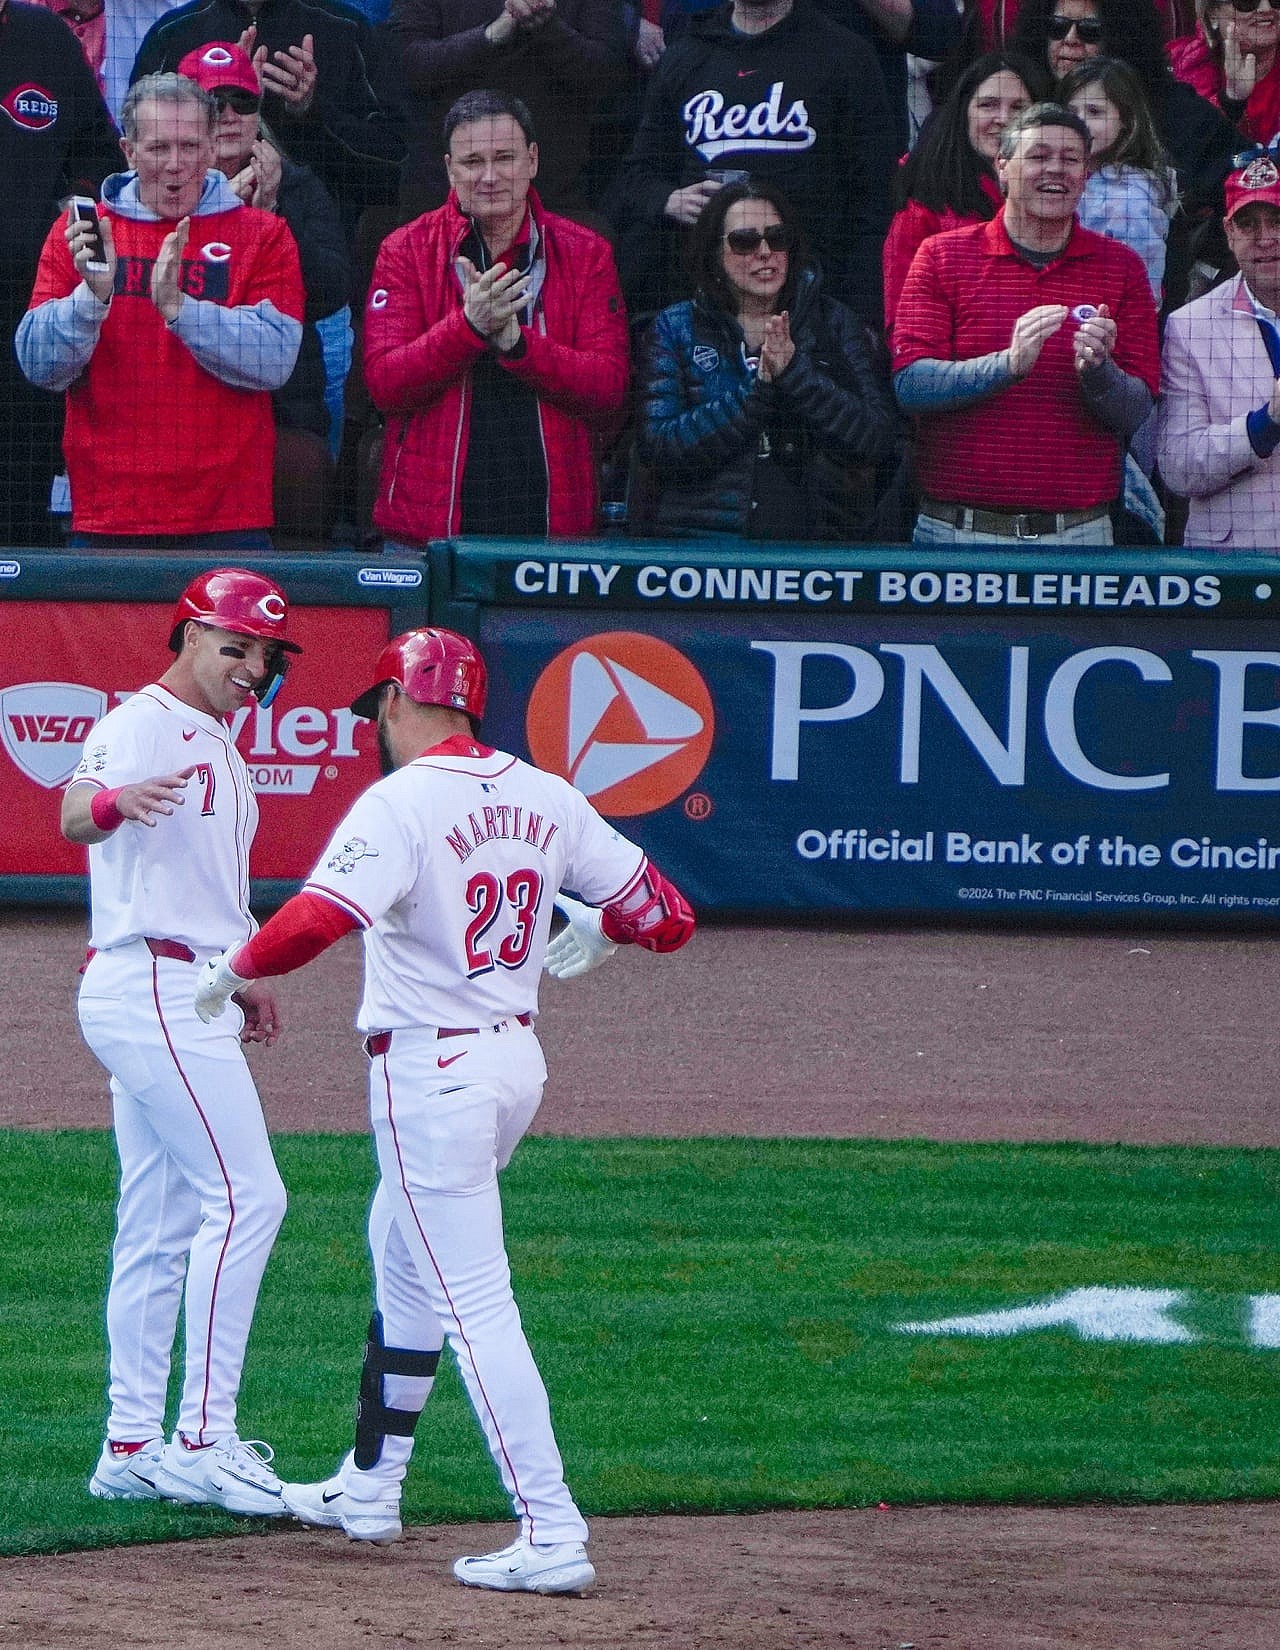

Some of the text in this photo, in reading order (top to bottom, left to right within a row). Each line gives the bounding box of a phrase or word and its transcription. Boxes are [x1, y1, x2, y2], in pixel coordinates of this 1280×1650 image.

[18, 99, 58, 115] REDS
[684, 81, 816, 162] Reds
[201, 242, 232, 261] C
[364, 571, 418, 583] Van Wagner
[514, 560, 1221, 607] CITY CONNECT BOBBLEHEADS
[257, 594, 285, 620] C
[7, 714, 96, 743] WSO
[750, 640, 1173, 791] PNC
[196, 762, 216, 817] 7
[445, 805, 559, 864] MARTINI
[796, 829, 934, 861] Official
[946, 832, 1044, 864] Bank
[1051, 835, 1091, 866] of
[1098, 836, 1162, 867] the
[996, 888, 1017, 900] The
[1019, 889, 1043, 900] PNC
[1045, 890, 1093, 902] Financial
[1095, 891, 1140, 903] Services
[1143, 892, 1178, 906] Group,
[1180, 893, 1199, 904] Inc.
[1201, 893, 1216, 904] All
[1219, 894, 1250, 907] rights
[464, 868, 544, 980] 23
